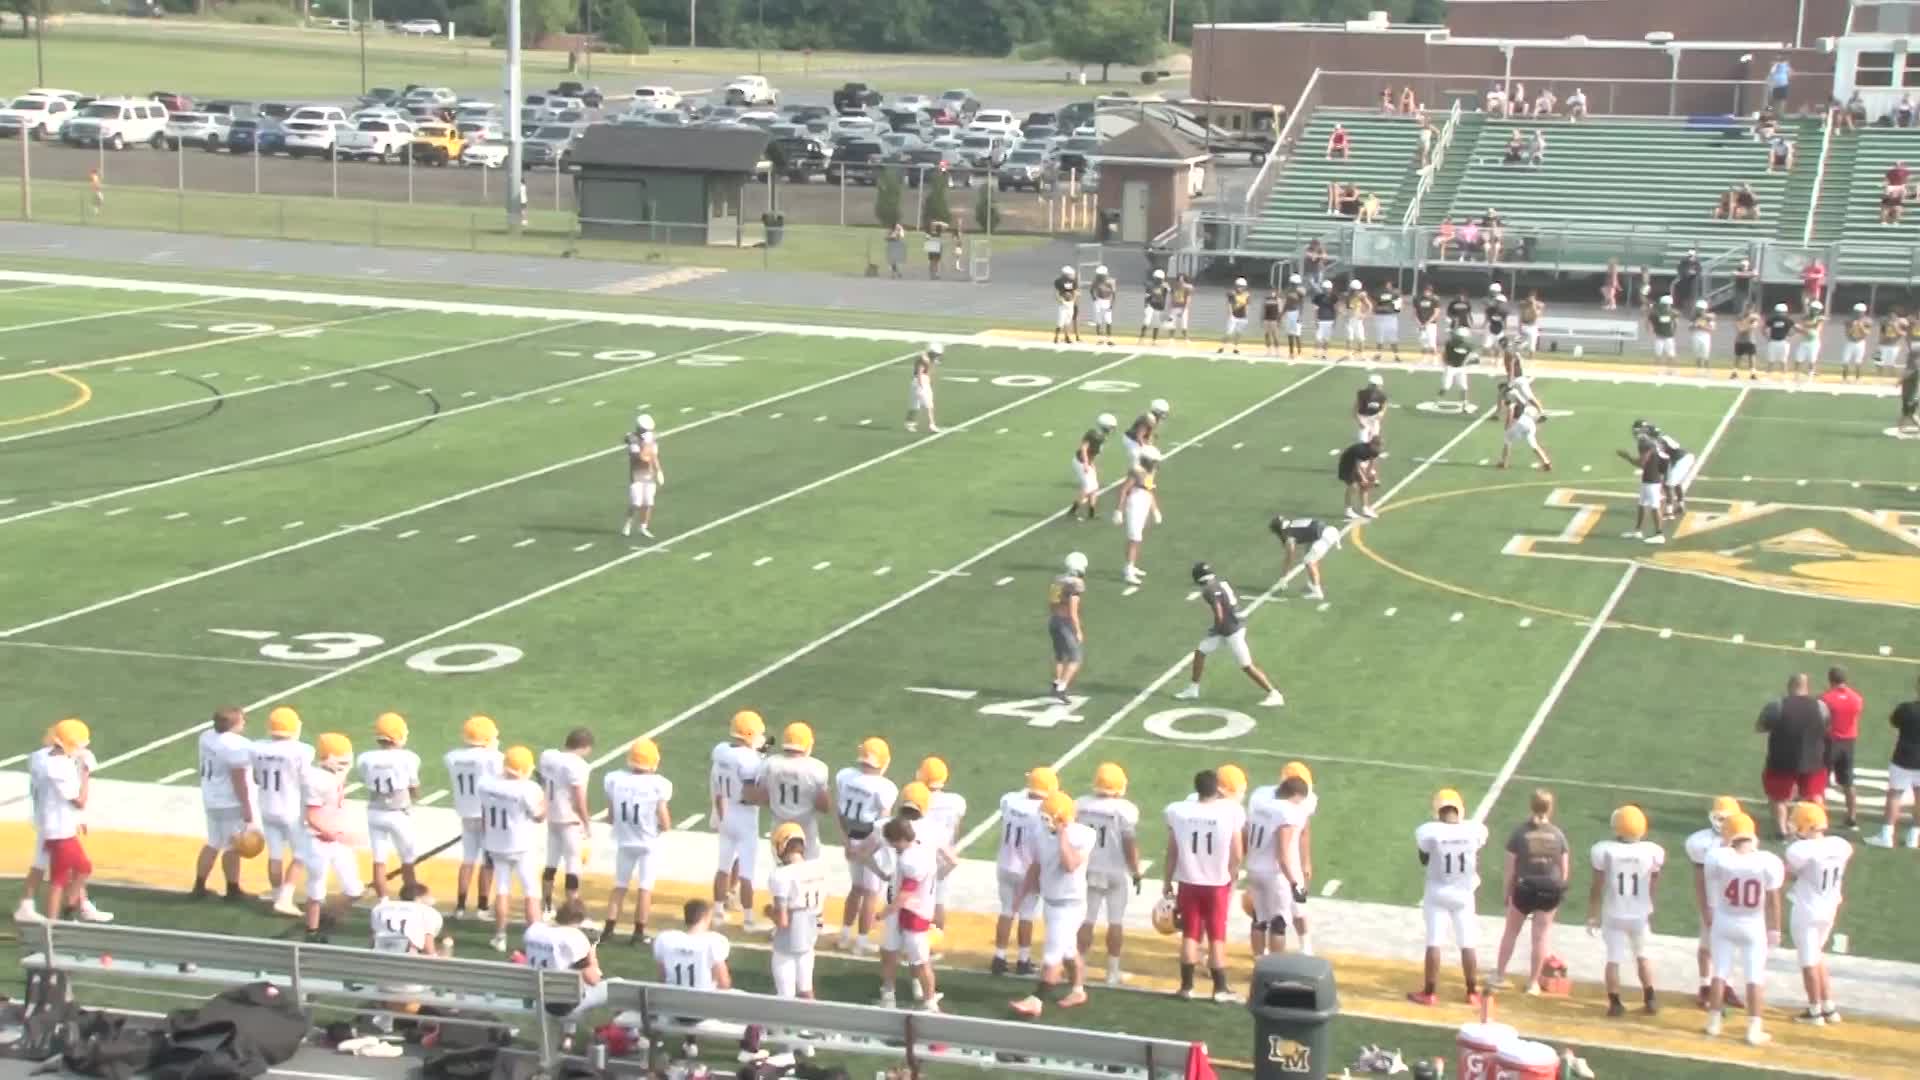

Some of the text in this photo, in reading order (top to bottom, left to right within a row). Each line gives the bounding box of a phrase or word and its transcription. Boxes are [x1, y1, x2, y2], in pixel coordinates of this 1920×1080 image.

[262, 769, 281, 792] 11
[373, 775, 395, 795] 11
[457, 773, 476, 796] 11
[778, 782, 800, 805] 11
[489, 805, 508, 831] 11
[620, 801, 640, 825] 11
[1004, 822, 1023, 848] 11
[1191, 830, 1213, 856] 11
[1444, 851, 1466, 875] 11
[1616, 871, 1640, 897] 11
[1723, 878, 1763, 909] 40
[674, 962, 695, 988] 11
